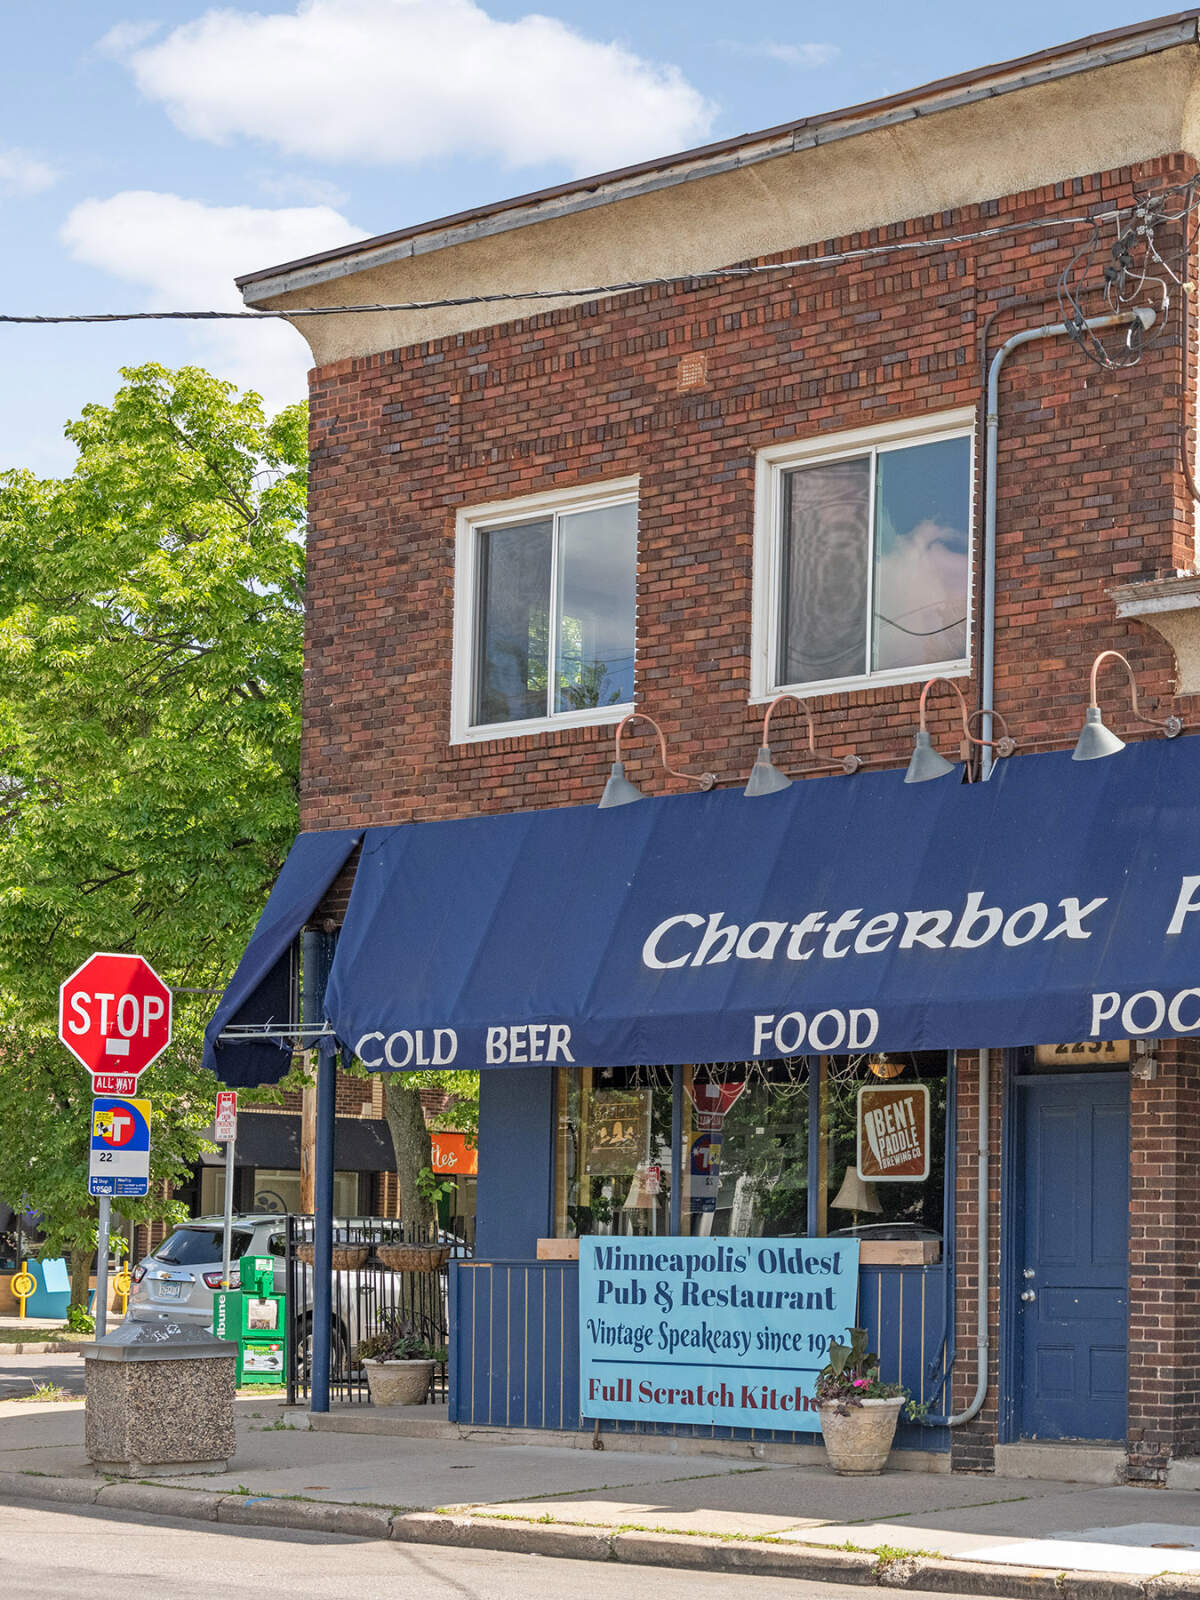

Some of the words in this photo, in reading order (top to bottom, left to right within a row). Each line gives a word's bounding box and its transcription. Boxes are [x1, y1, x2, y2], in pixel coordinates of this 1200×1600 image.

[642, 891, 1107, 969] Chatterbox
[68, 991, 165, 1038] STOP
[752, 1008, 879, 1056] FOOD
[355, 1028, 459, 1068] COLD
[485, 1024, 576, 1064] BEER
[96, 1077, 114, 1089] ALL
[116, 1078, 134, 1091] WAY
[873, 1097, 915, 1137] BENT
[99, 1152, 113, 1162] 22
[879, 1126, 919, 1158] PADDLE
[593, 1246, 751, 1279] Minneapolis'
[758, 1248, 843, 1276] Oldest
[597, 1279, 647, 1305] Pub
[653, 1280, 675, 1313] &
[681, 1281, 837, 1311] Restaurant
[587, 1318, 653, 1353] Vintage
[658, 1320, 752, 1357] Speakeasy
[756, 1326, 802, 1353] since
[589, 1378, 633, 1403] Full
[638, 1380, 735, 1409] Scratch
